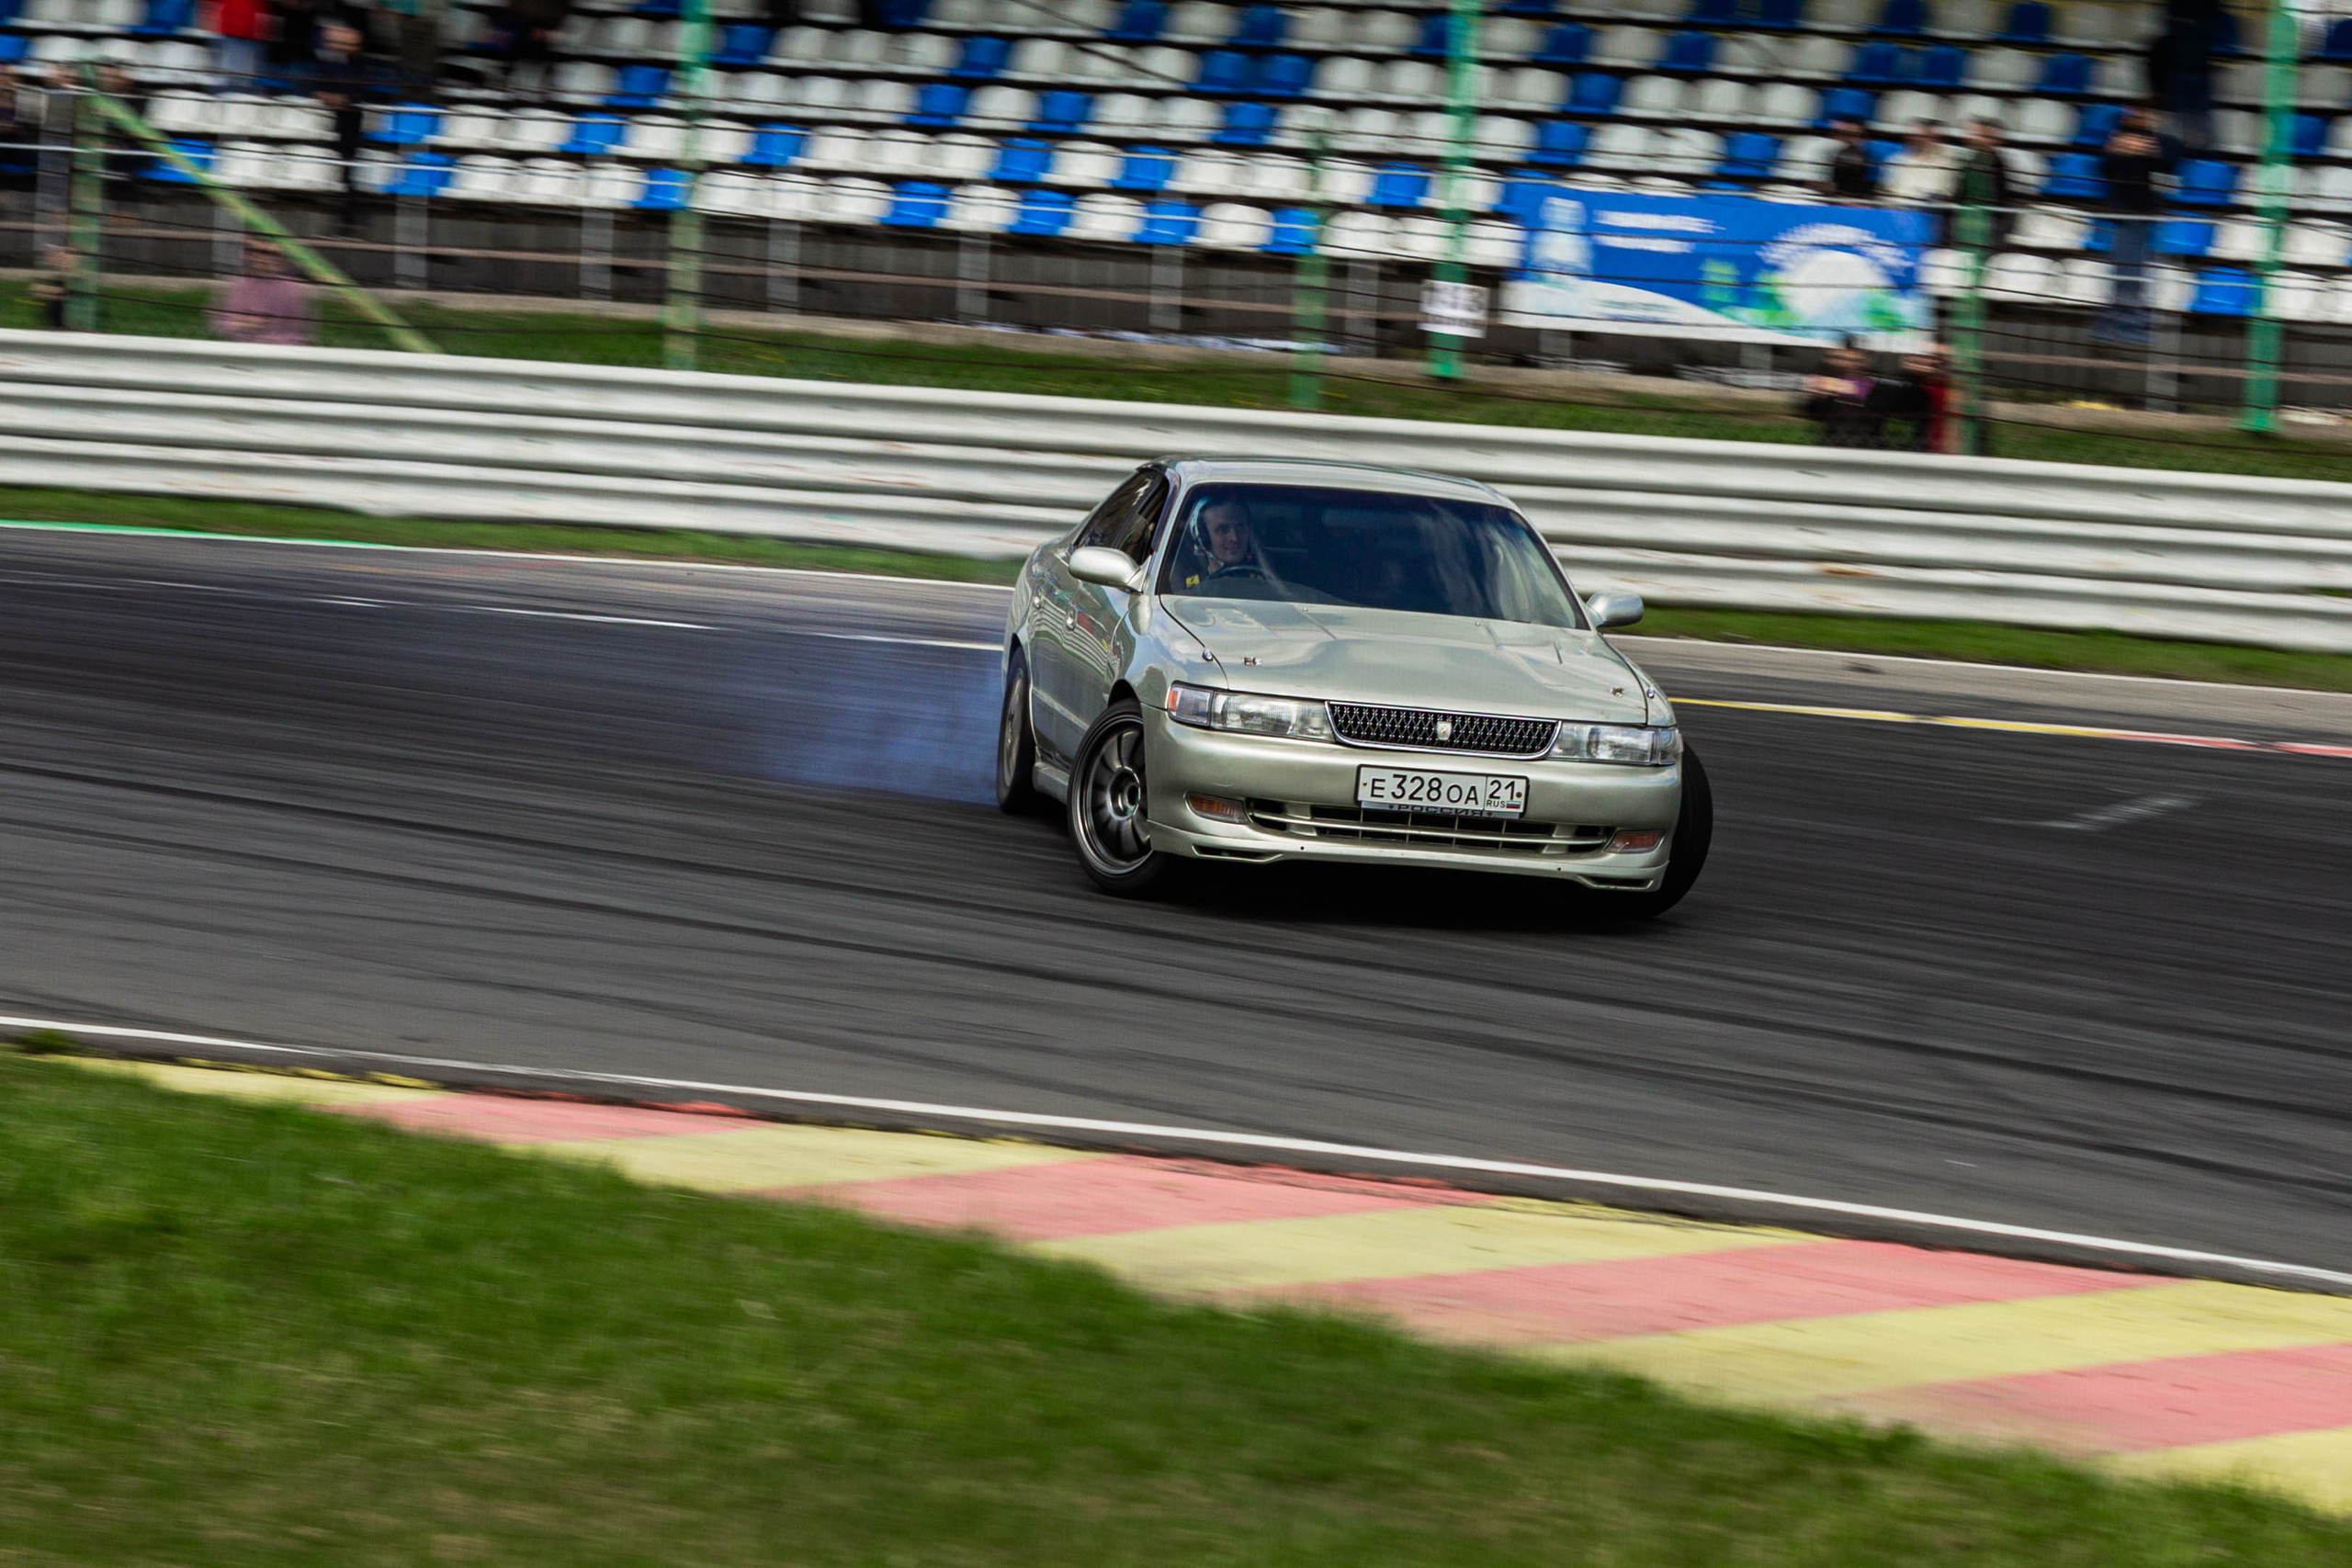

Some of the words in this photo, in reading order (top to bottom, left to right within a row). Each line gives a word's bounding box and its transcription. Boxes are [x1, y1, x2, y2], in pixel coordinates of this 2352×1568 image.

[1488, 780, 1515, 800] 21
[1397, 804, 1483, 816] РОССИЯ
[1486, 800, 1506, 808] RUS
